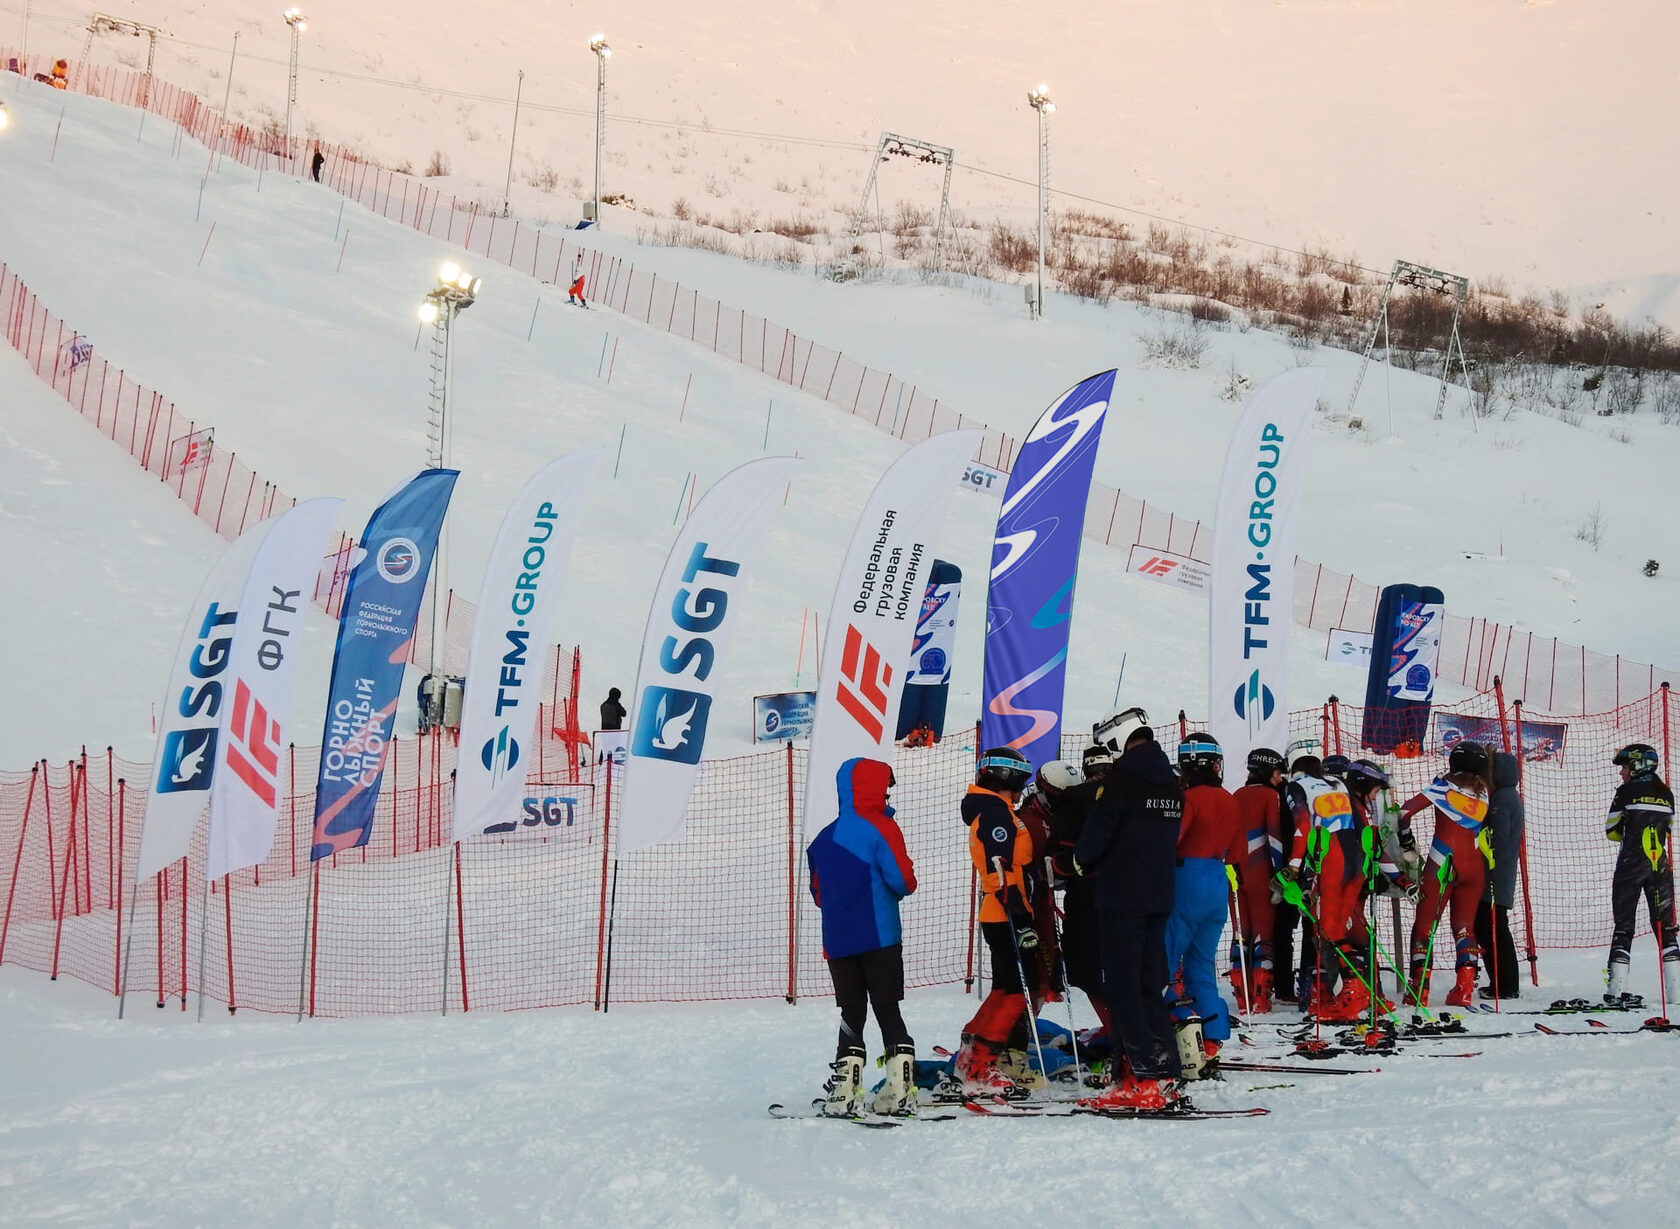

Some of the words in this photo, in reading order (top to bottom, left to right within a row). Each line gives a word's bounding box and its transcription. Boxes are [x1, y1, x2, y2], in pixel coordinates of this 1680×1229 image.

[853, 510, 897, 613] Федеральная
[876, 547, 903, 618] грузовая
[894, 543, 925, 621] компания
[257, 585, 300, 671] ФГК
[659, 541, 740, 682] SGT
[179, 602, 238, 718] SGT
[323, 700, 353, 781] ГОРНО
[342, 678, 375, 786] ЛЫЖНЫЙ
[360, 708, 388, 788] СПОРТ
[523, 797, 577, 826] SGT
[1146, 799, 1180, 810] RUSSIA
[1324, 793, 1350, 813] 12
